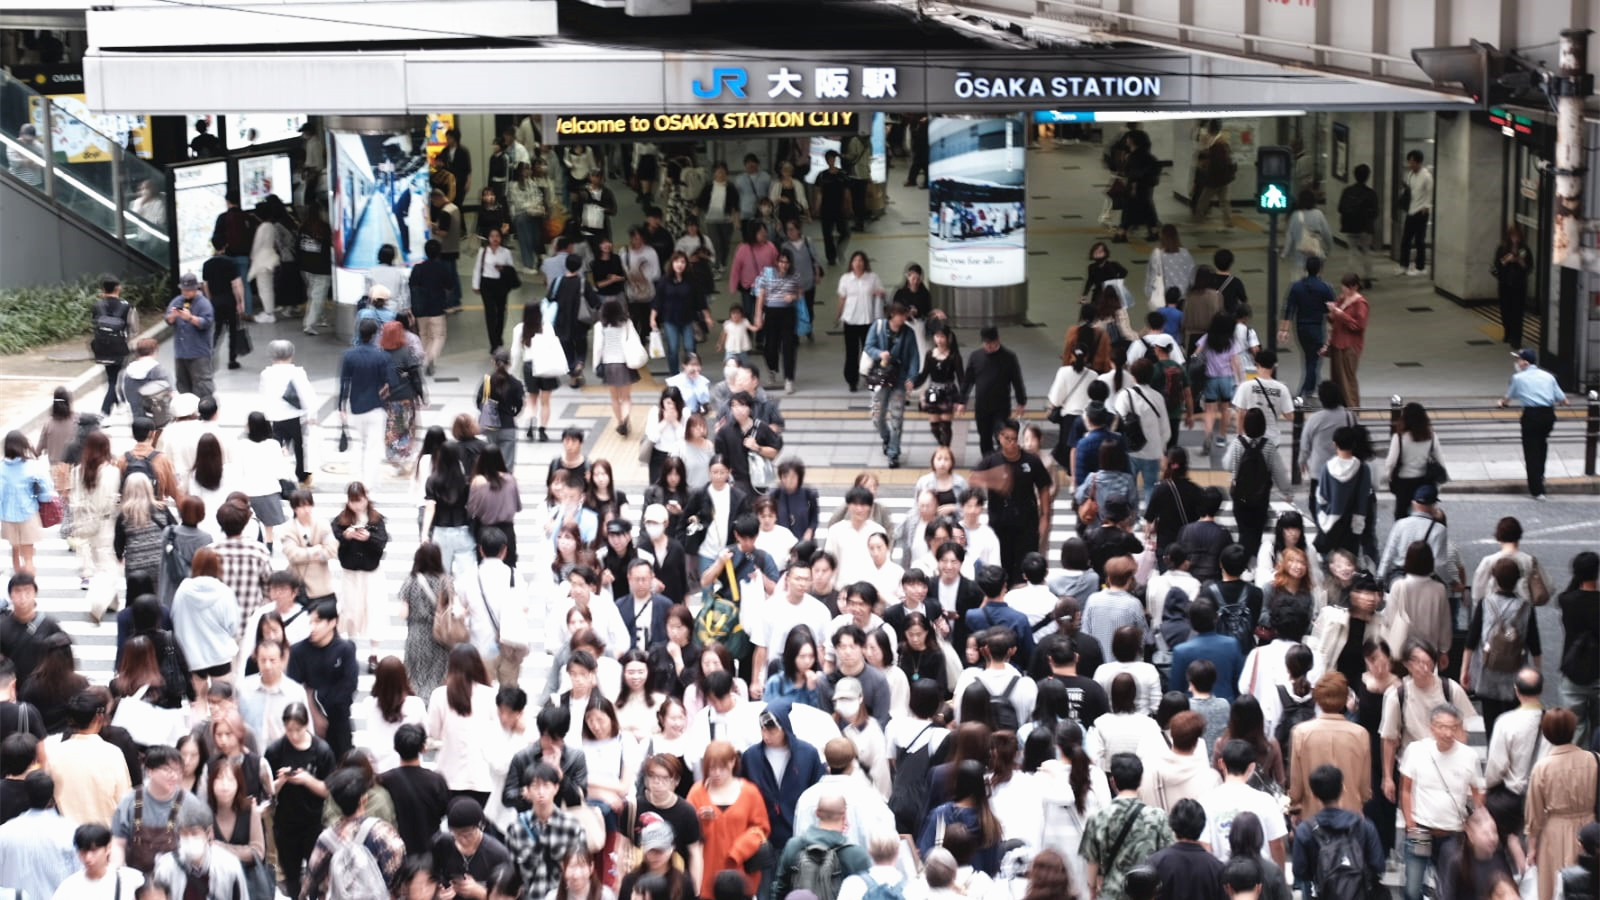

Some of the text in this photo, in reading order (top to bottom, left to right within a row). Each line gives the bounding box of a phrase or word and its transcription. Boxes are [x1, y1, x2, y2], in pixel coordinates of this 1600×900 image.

[692, 67, 897, 99] JR 大阪駅
[1051, 76, 1160, 97] STATION
[630, 115, 650, 132] to
[653, 113, 719, 131] OSAKA
[722, 111, 804, 129] STATION
[808, 111, 852, 126] CITY
